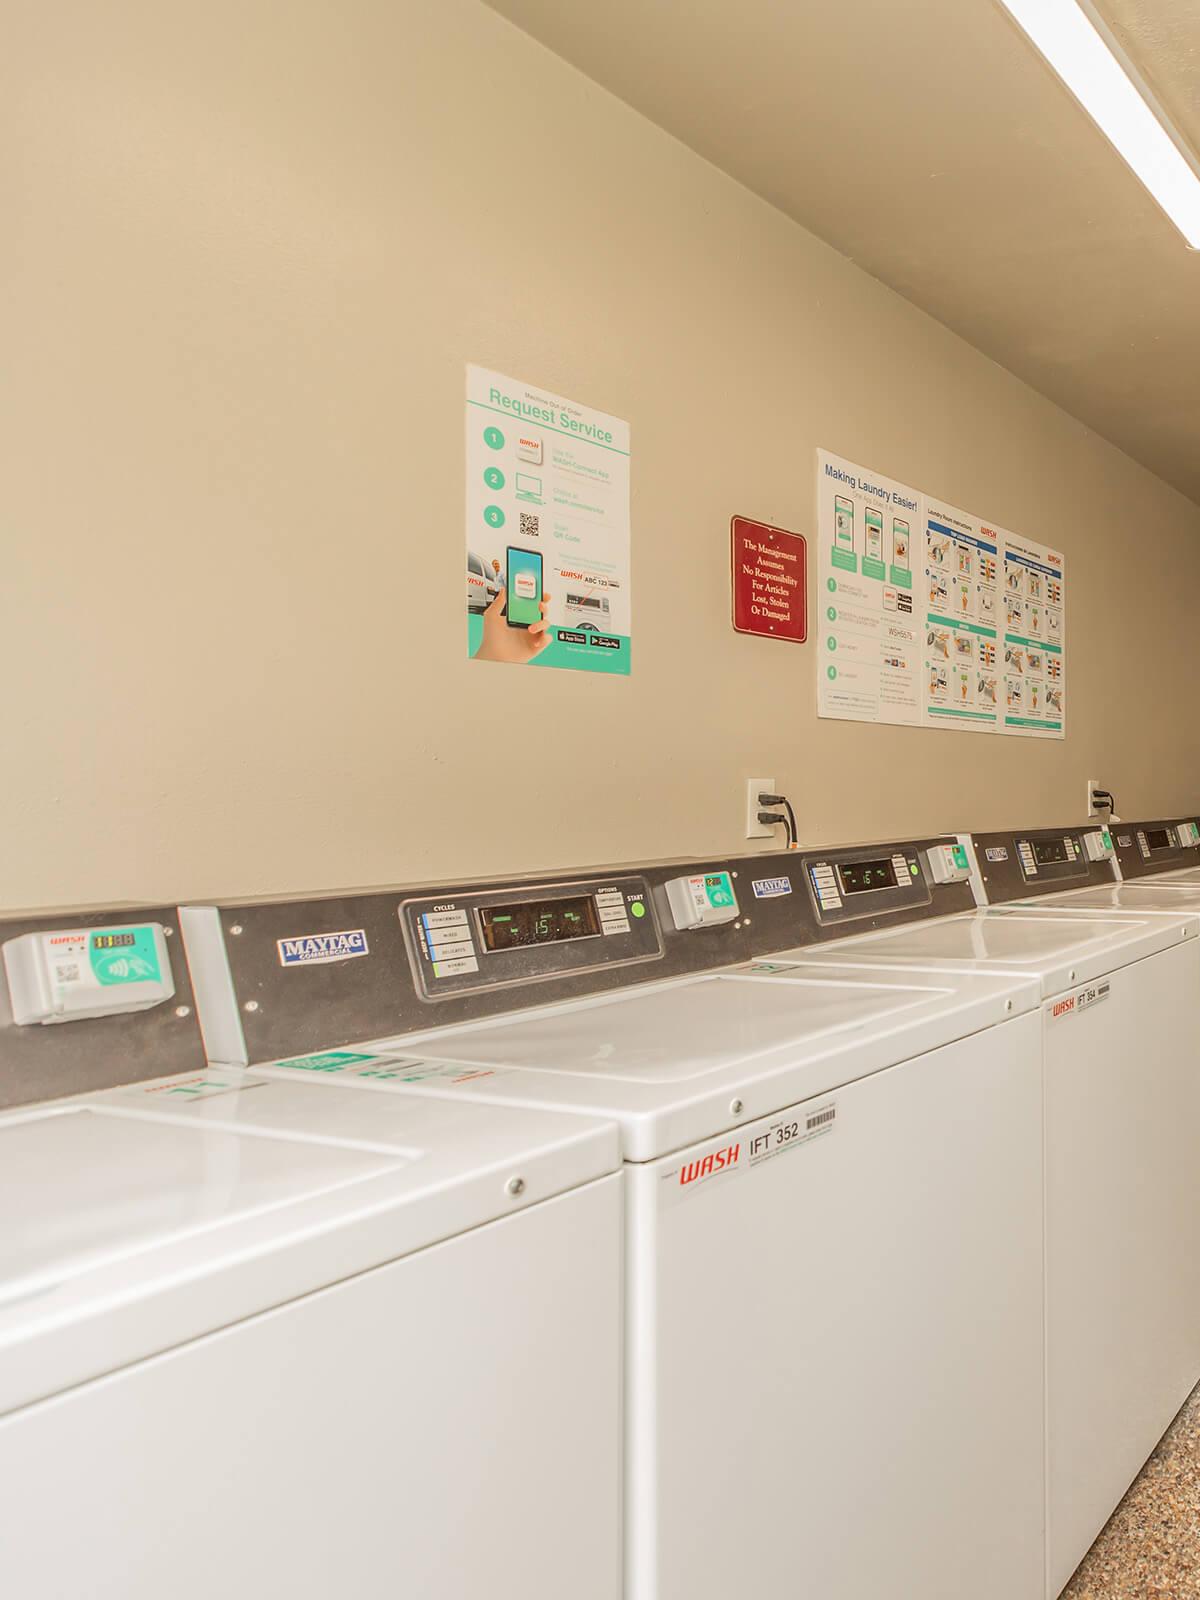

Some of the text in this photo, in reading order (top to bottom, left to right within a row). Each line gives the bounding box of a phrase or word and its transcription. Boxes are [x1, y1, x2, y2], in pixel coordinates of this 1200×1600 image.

[489, 387, 613, 443] Request Service
[825, 463, 918, 512] Making Laundry Easier!
[980, 526, 997, 539] WASH
[744, 538, 797, 562] The Management
[757, 556, 785, 571] Assumes
[560, 569, 583, 580] WASH
[742, 565, 798, 588] No Responsibility
[752, 580, 789, 597] For Articles
[752, 593, 789, 609] Lost, Stolen
[751, 606, 791, 622] Or Damaged
[755, 879, 789, 893] MAYTAG
[626, 894, 643, 902] START
[433, 904, 455, 912] CYCLES
[536, 919, 548, 934] 15
[50, 936, 85, 945] WASH
[284, 933, 362, 957] MAYTAG
[299, 947, 352, 960] COMMERCIAL
[1053, 996, 1075, 1016] WASH
[680, 1143, 741, 1185] WASH
[750, 1133, 771, 1155] IFT
[776, 1122, 799, 1144] 352
